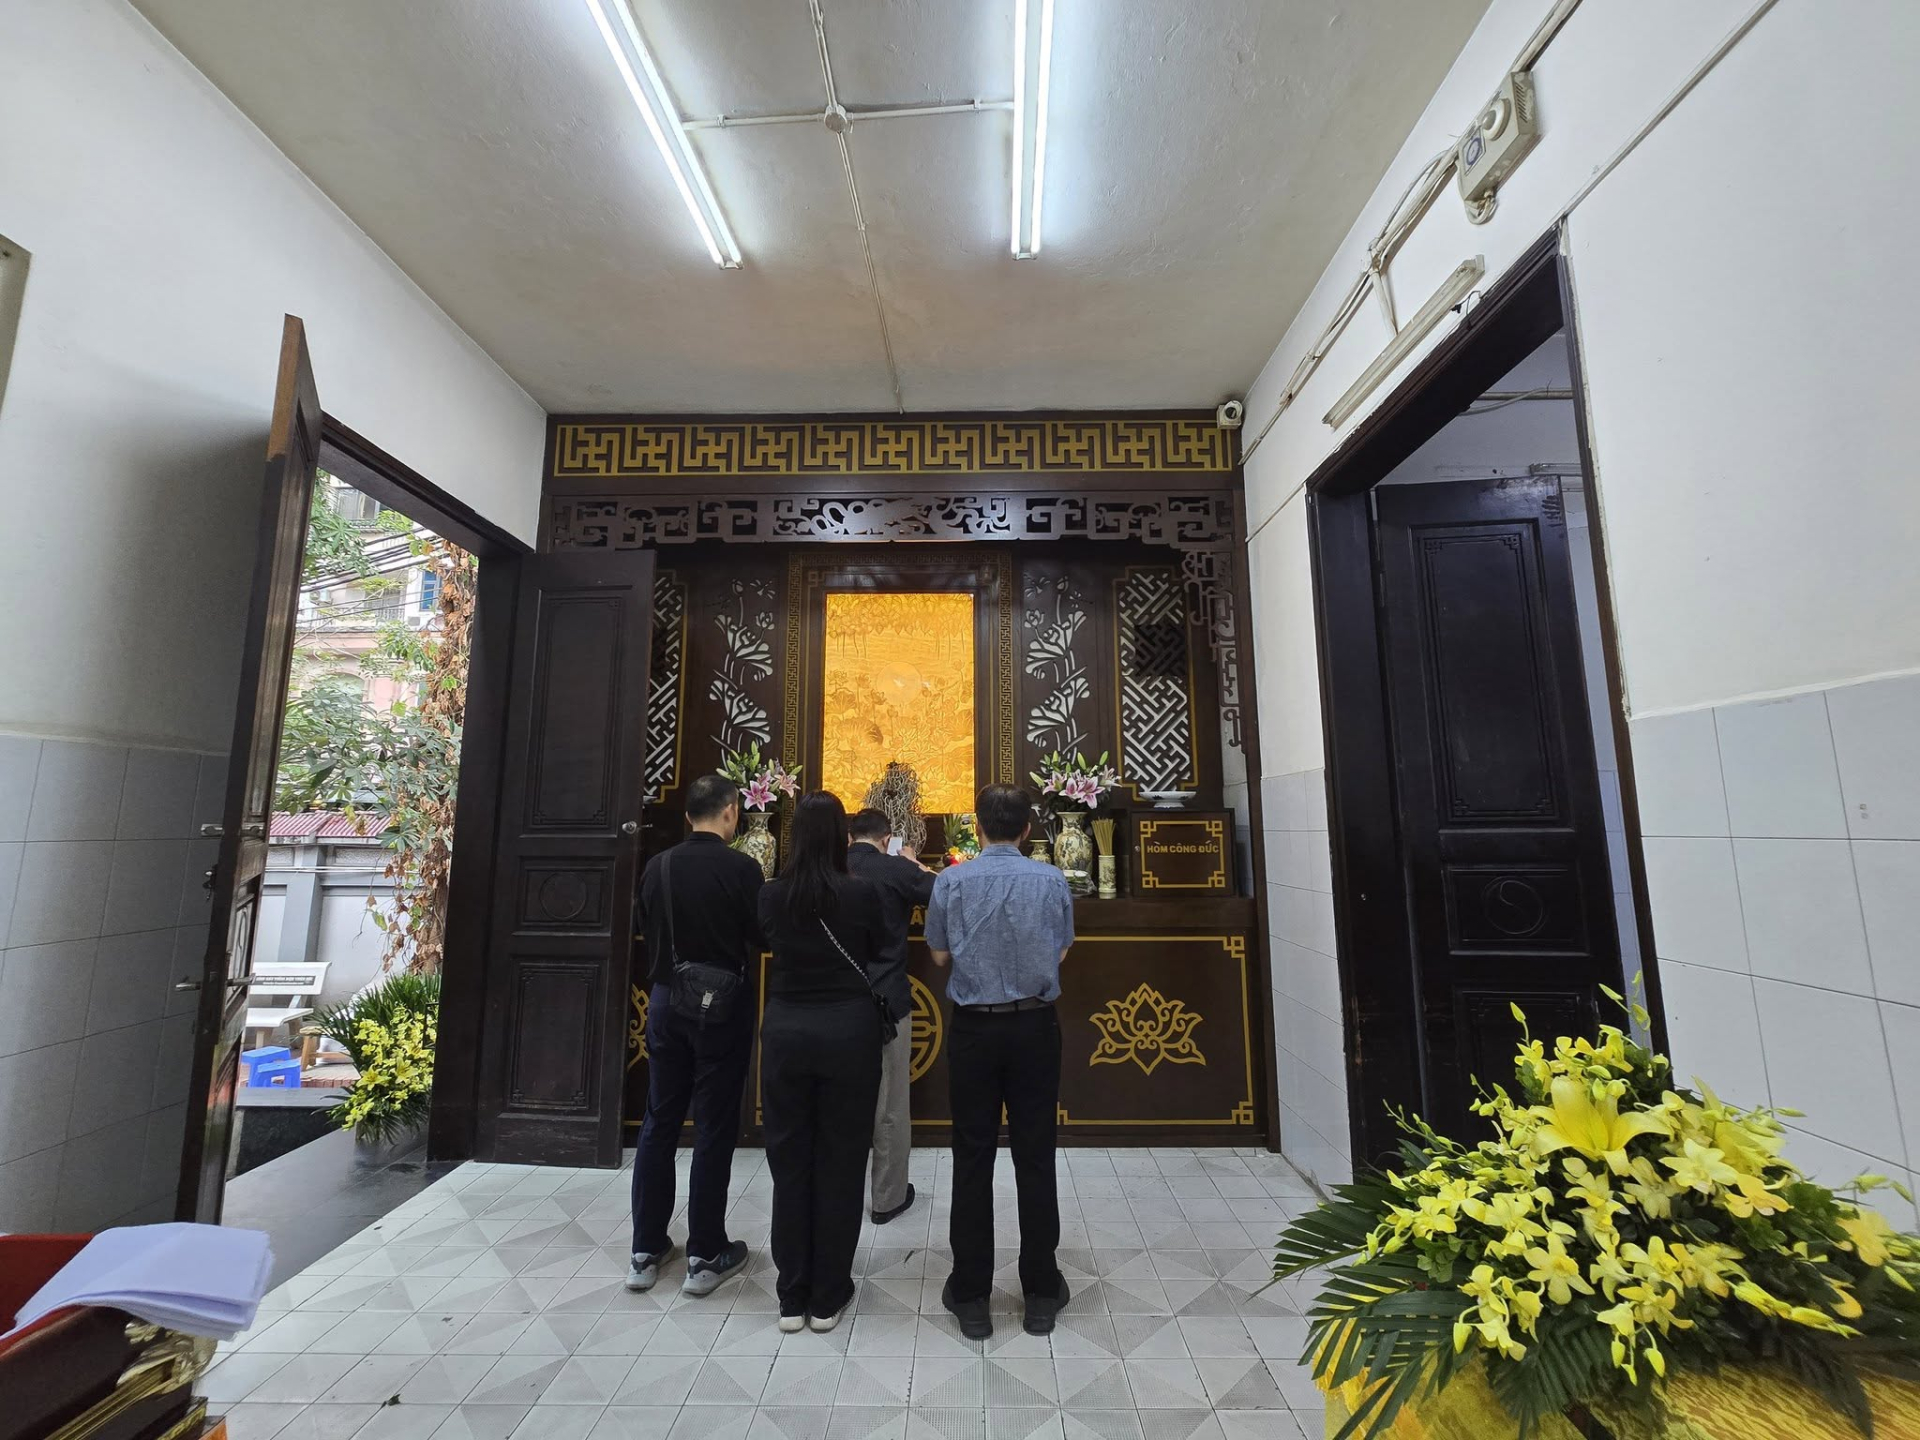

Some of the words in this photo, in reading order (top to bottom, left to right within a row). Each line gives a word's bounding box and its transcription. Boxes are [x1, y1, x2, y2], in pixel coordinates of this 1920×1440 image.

[1146, 841, 1168, 853] HÒM
[1169, 842, 1197, 853] CÔNG
[1198, 840, 1219, 853] ĐỨC
